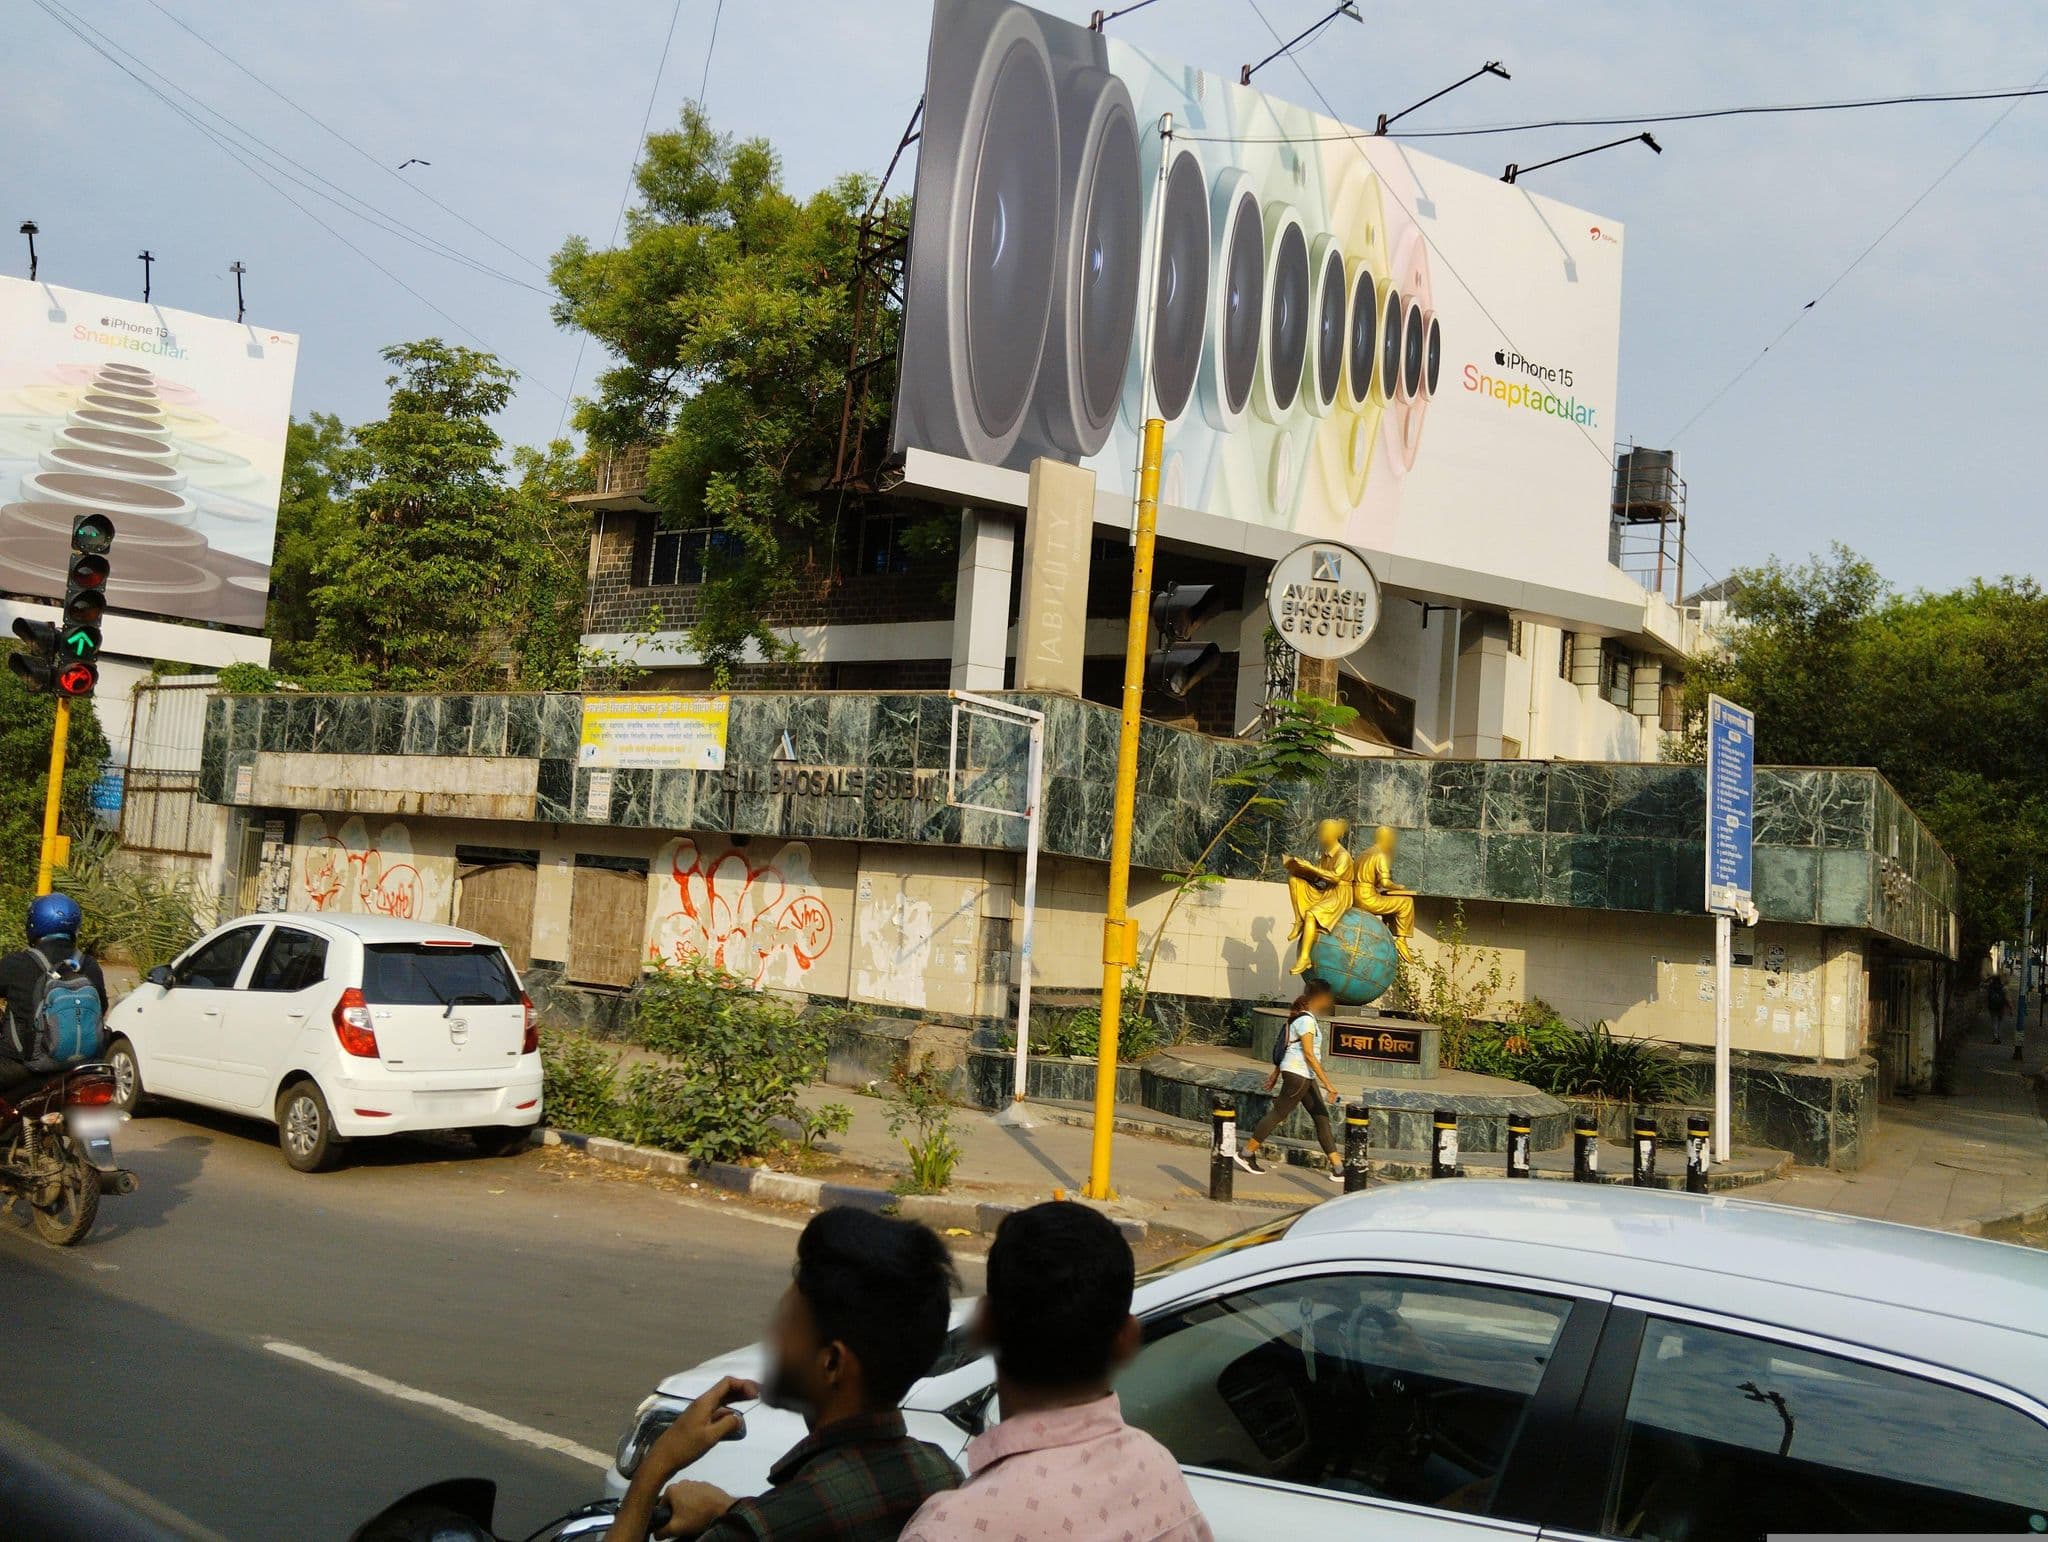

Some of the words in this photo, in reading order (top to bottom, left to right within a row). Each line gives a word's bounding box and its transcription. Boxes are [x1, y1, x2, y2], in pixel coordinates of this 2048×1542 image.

[111, 317, 152, 336] iPhone
[155, 326, 169, 339] 15
[73, 324, 189, 361] Snaptacular.
[1507, 351, 1557, 382] iPhone
[1558, 368, 1574, 388] 15
[1463, 363, 1598, 428] Snaptacular.
[1281, 583, 1367, 607] AVINASH
[1281, 600, 1364, 624] BHOSALE
[1281, 616, 1364, 639] GROUP
[768, 769, 863, 798] BHOSALE
[1340, 1033, 1374, 1051] प्रज्ञा
[1378, 1033, 1416, 1053] शिल्प
